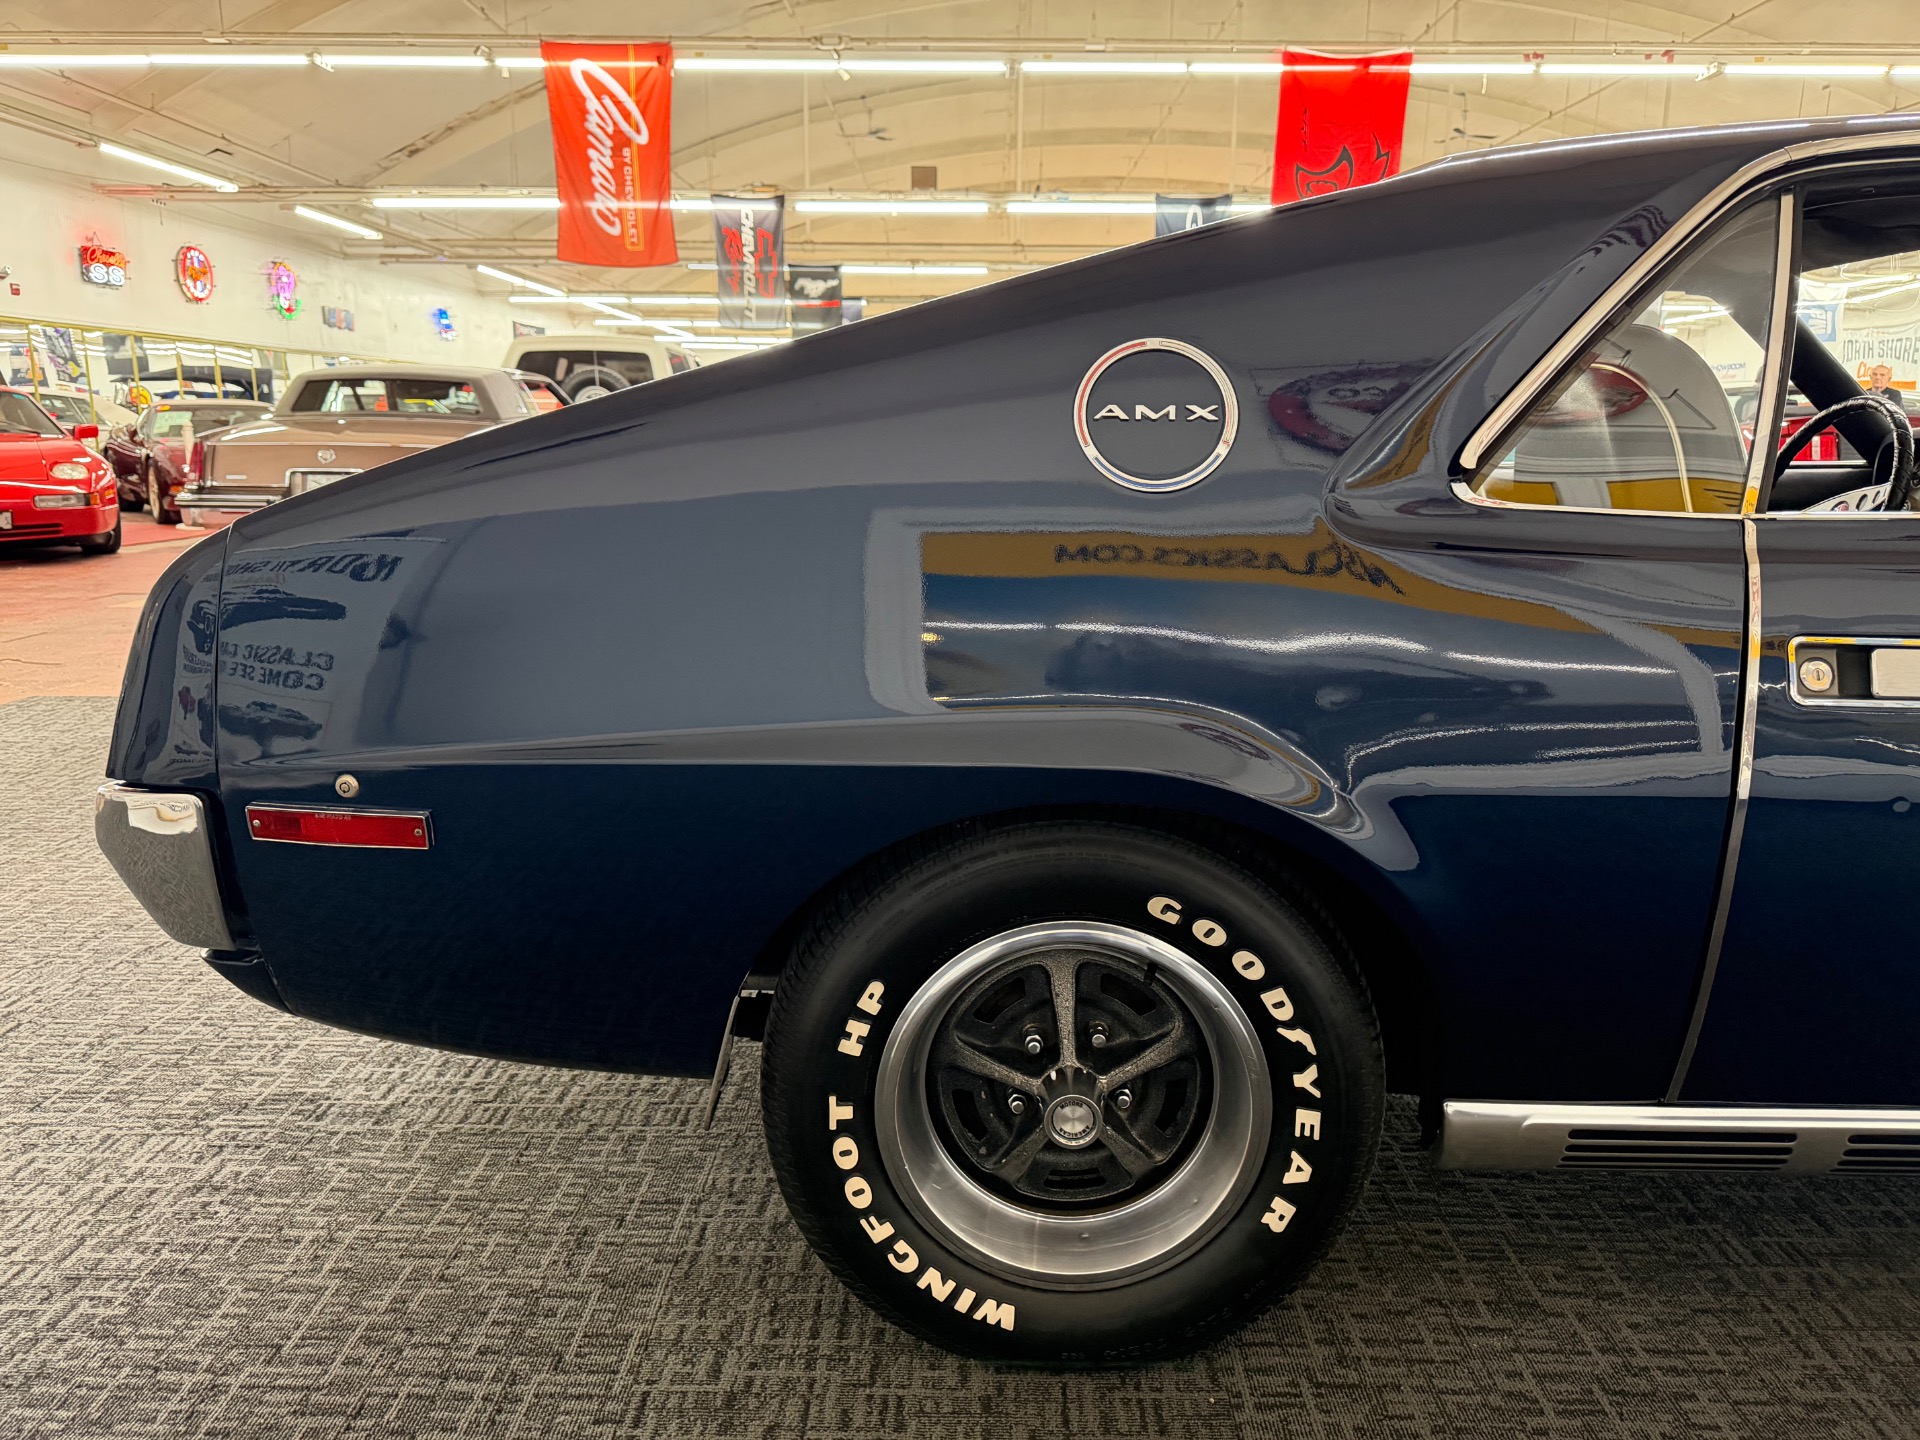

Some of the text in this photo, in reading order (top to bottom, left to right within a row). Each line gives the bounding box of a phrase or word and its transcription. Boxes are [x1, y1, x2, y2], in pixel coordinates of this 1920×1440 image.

[569, 57, 650, 236] Camaro
[621, 146, 634, 165] BY
[89, 263, 125, 286] SS
[1877, 336, 1920, 365] SHORE
[1093, 403, 1220, 421] AMX
[837, 979, 886, 1058] HP
[1146, 895, 1323, 1235] GOODYEAR
[1060, 1101, 1084, 1109] MOTORS
[1059, 1125, 1091, 1138] AMERICAN
[828, 1094, 1017, 1332] WINGFOOT
